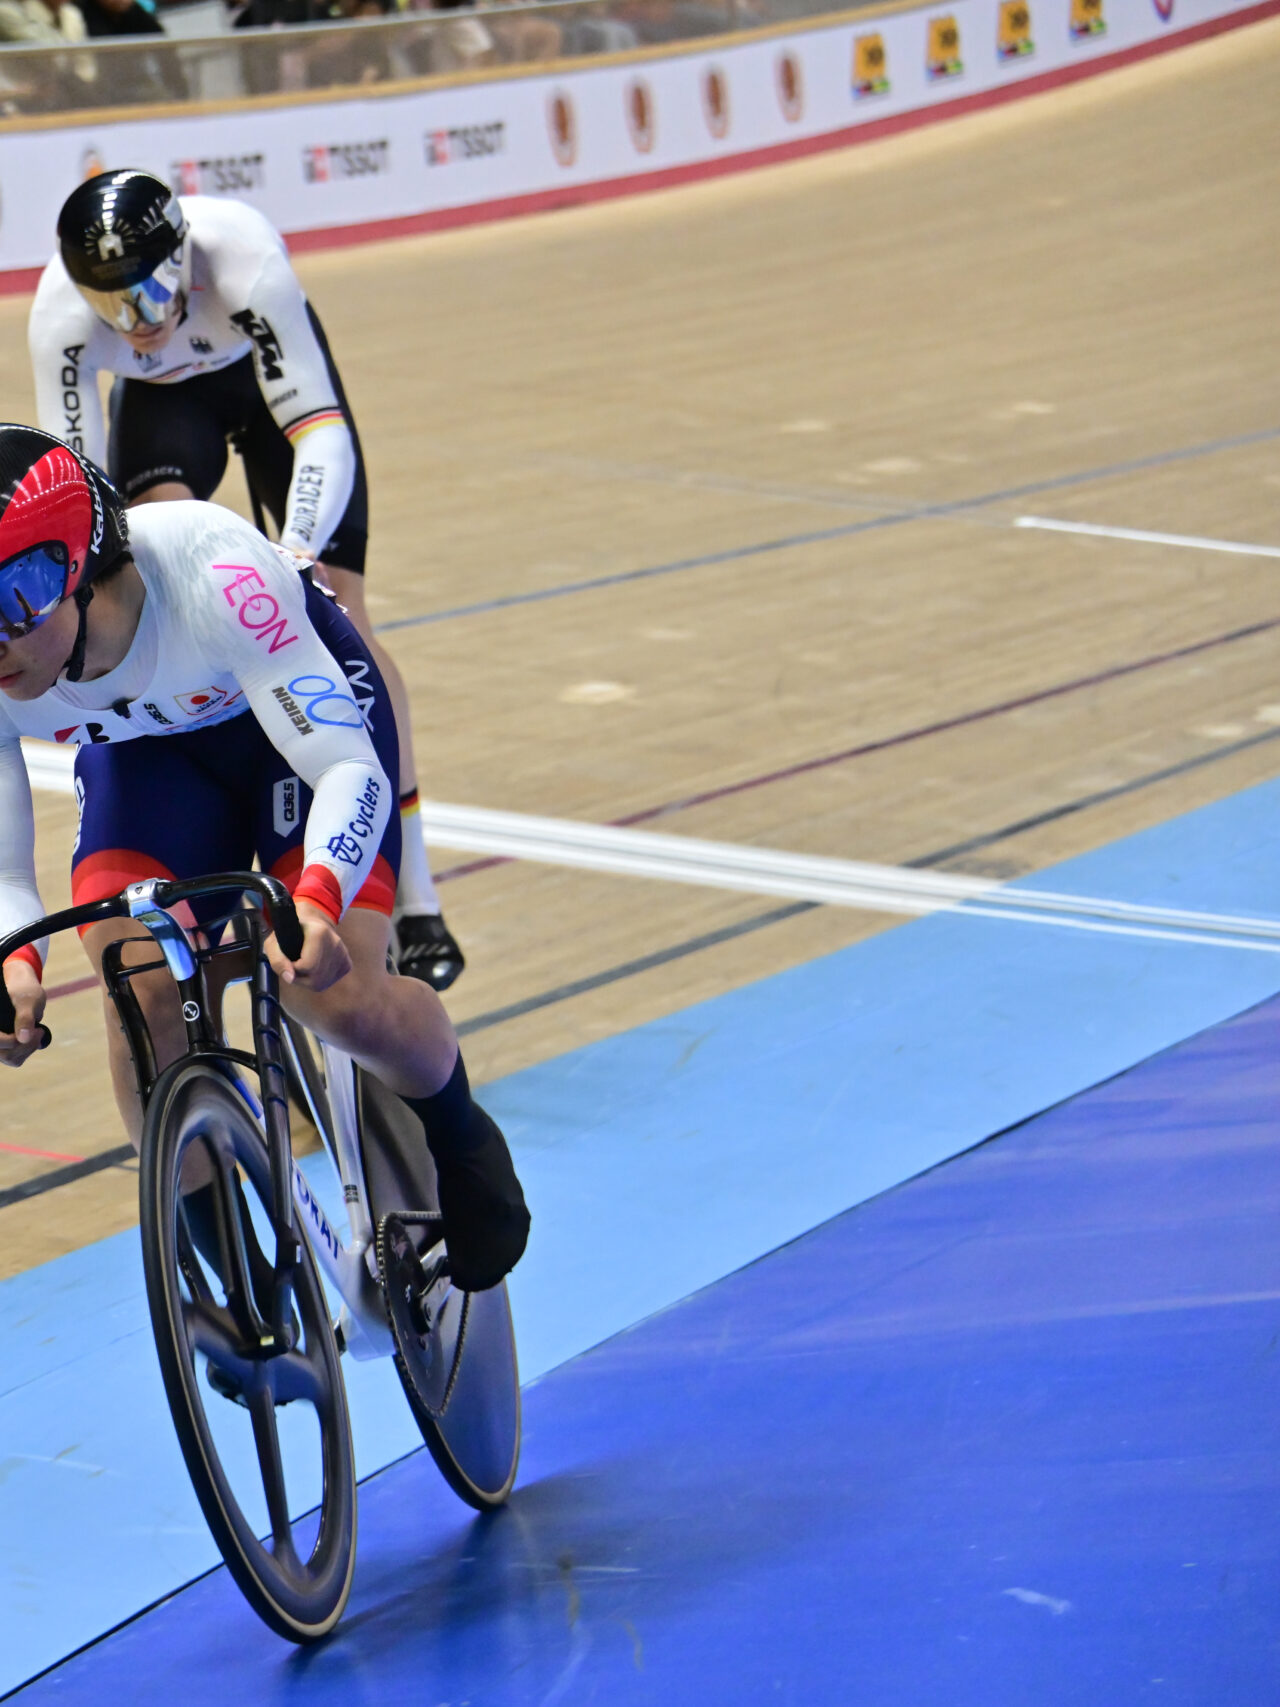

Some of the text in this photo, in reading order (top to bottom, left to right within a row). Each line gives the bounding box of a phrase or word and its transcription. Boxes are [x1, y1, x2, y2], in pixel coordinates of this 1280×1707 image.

[229, 308, 284, 382] KTM
[290, 465, 326, 543] BIORACER
[271, 686, 316, 737] KEIRIN
[347, 777, 381, 838] Cyclers
